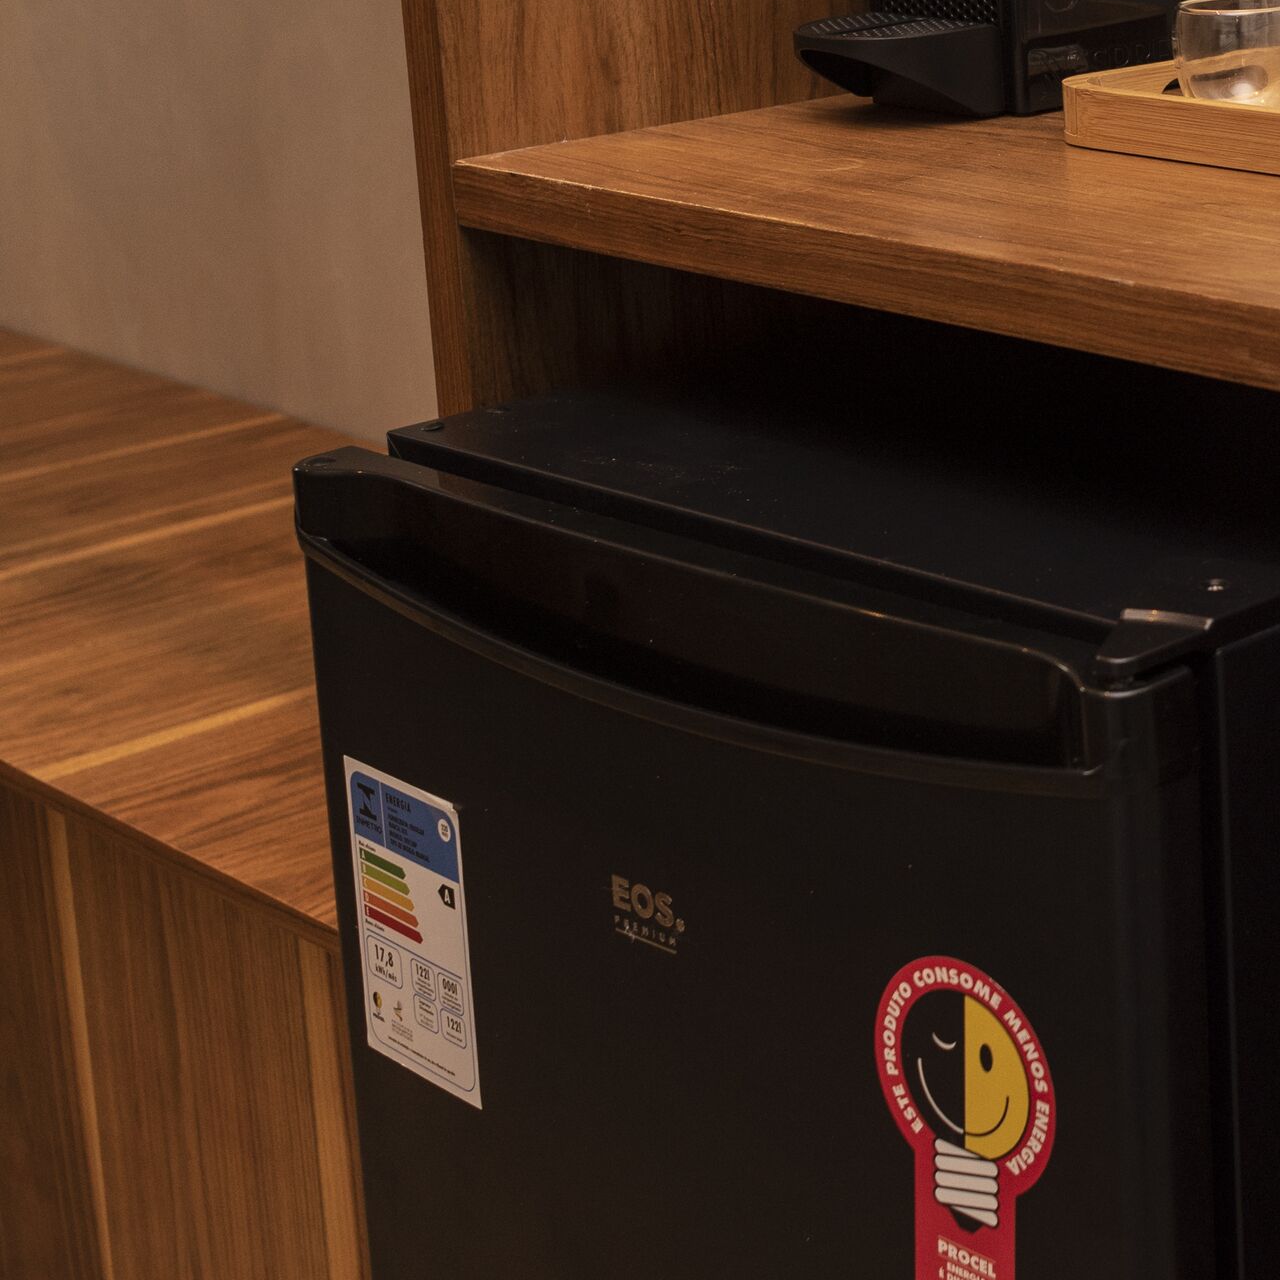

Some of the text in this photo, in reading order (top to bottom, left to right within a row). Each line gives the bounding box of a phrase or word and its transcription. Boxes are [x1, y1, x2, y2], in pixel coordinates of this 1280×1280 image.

[444, 888, 451, 905] A
[611, 873, 674, 928] EOS
[613, 914, 677, 946] PREMIUM
[374, 943, 394, 967] 17,8
[882, 965, 1050, 1177] ESTE PRODUTO CONSOME MENOS ENERGIA
[938, 1238, 996, 1279] PROCEL
